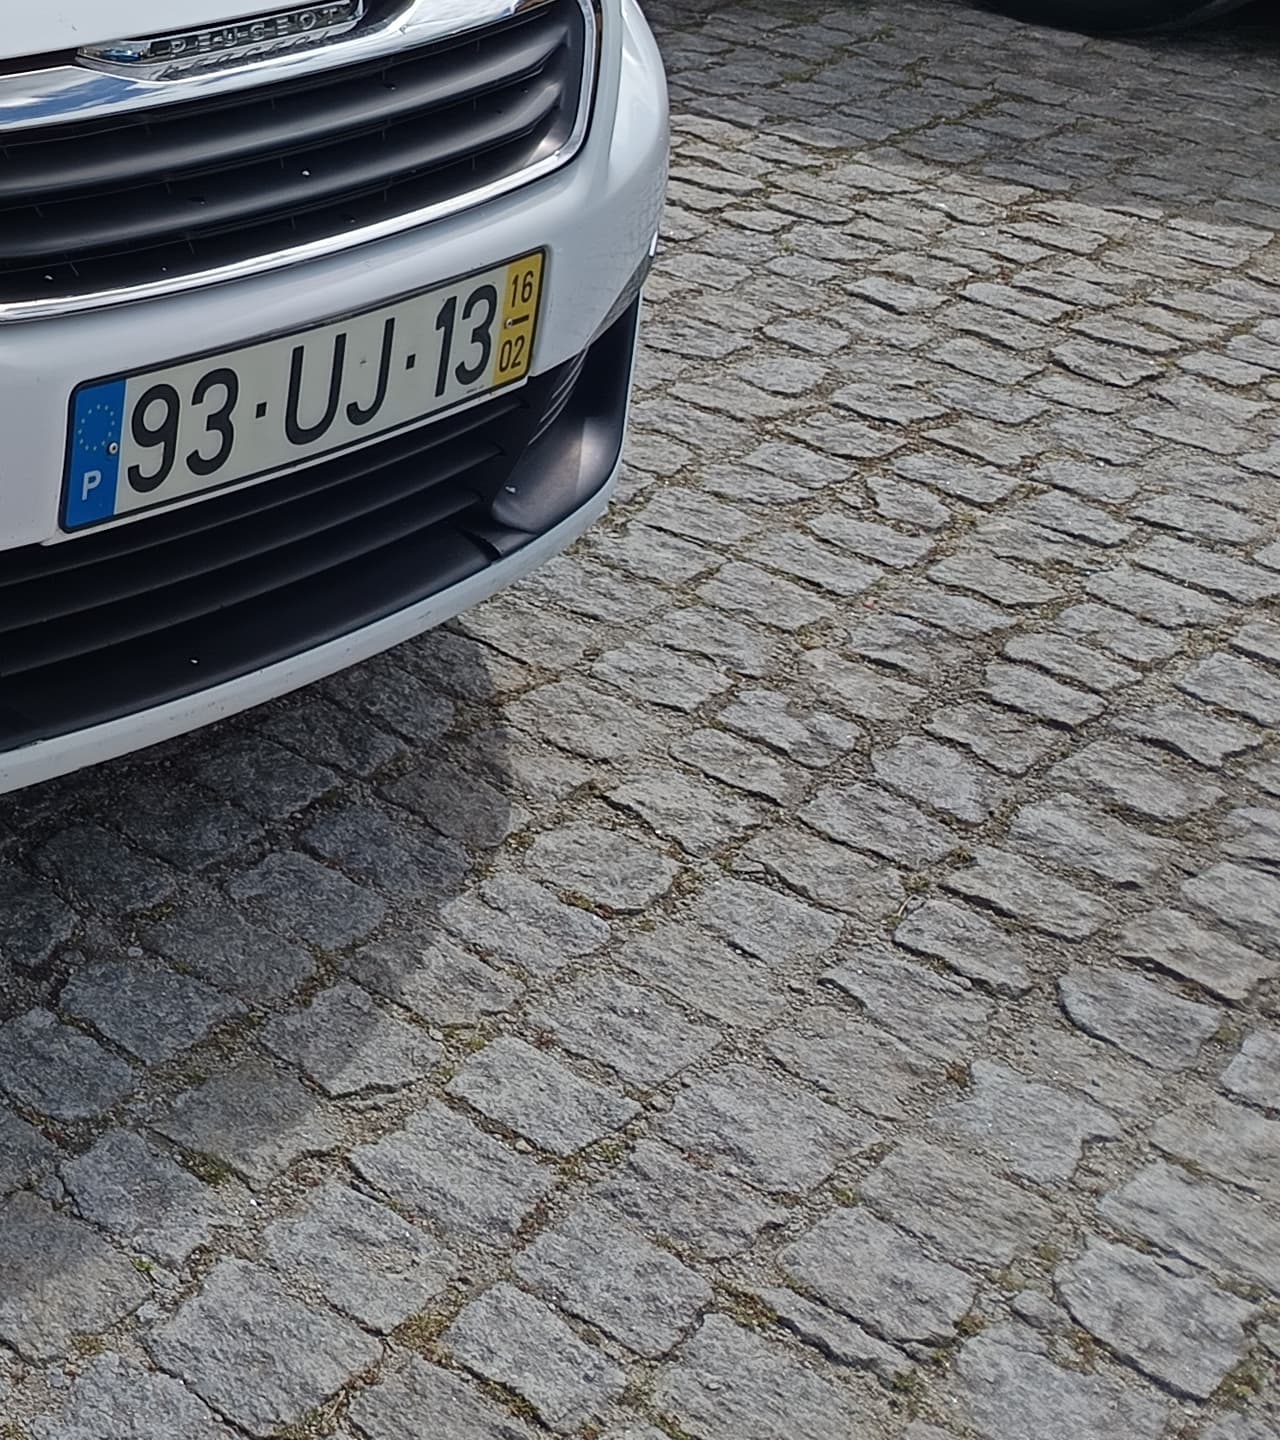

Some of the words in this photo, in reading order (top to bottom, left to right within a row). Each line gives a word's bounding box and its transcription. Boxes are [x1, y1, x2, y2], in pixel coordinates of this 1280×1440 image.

[169, 7, 339, 57] PEUGEOT
[511, 270, 534, 308] 16
[499, 335, 525, 372] 02
[81, 469, 102, 502] P
